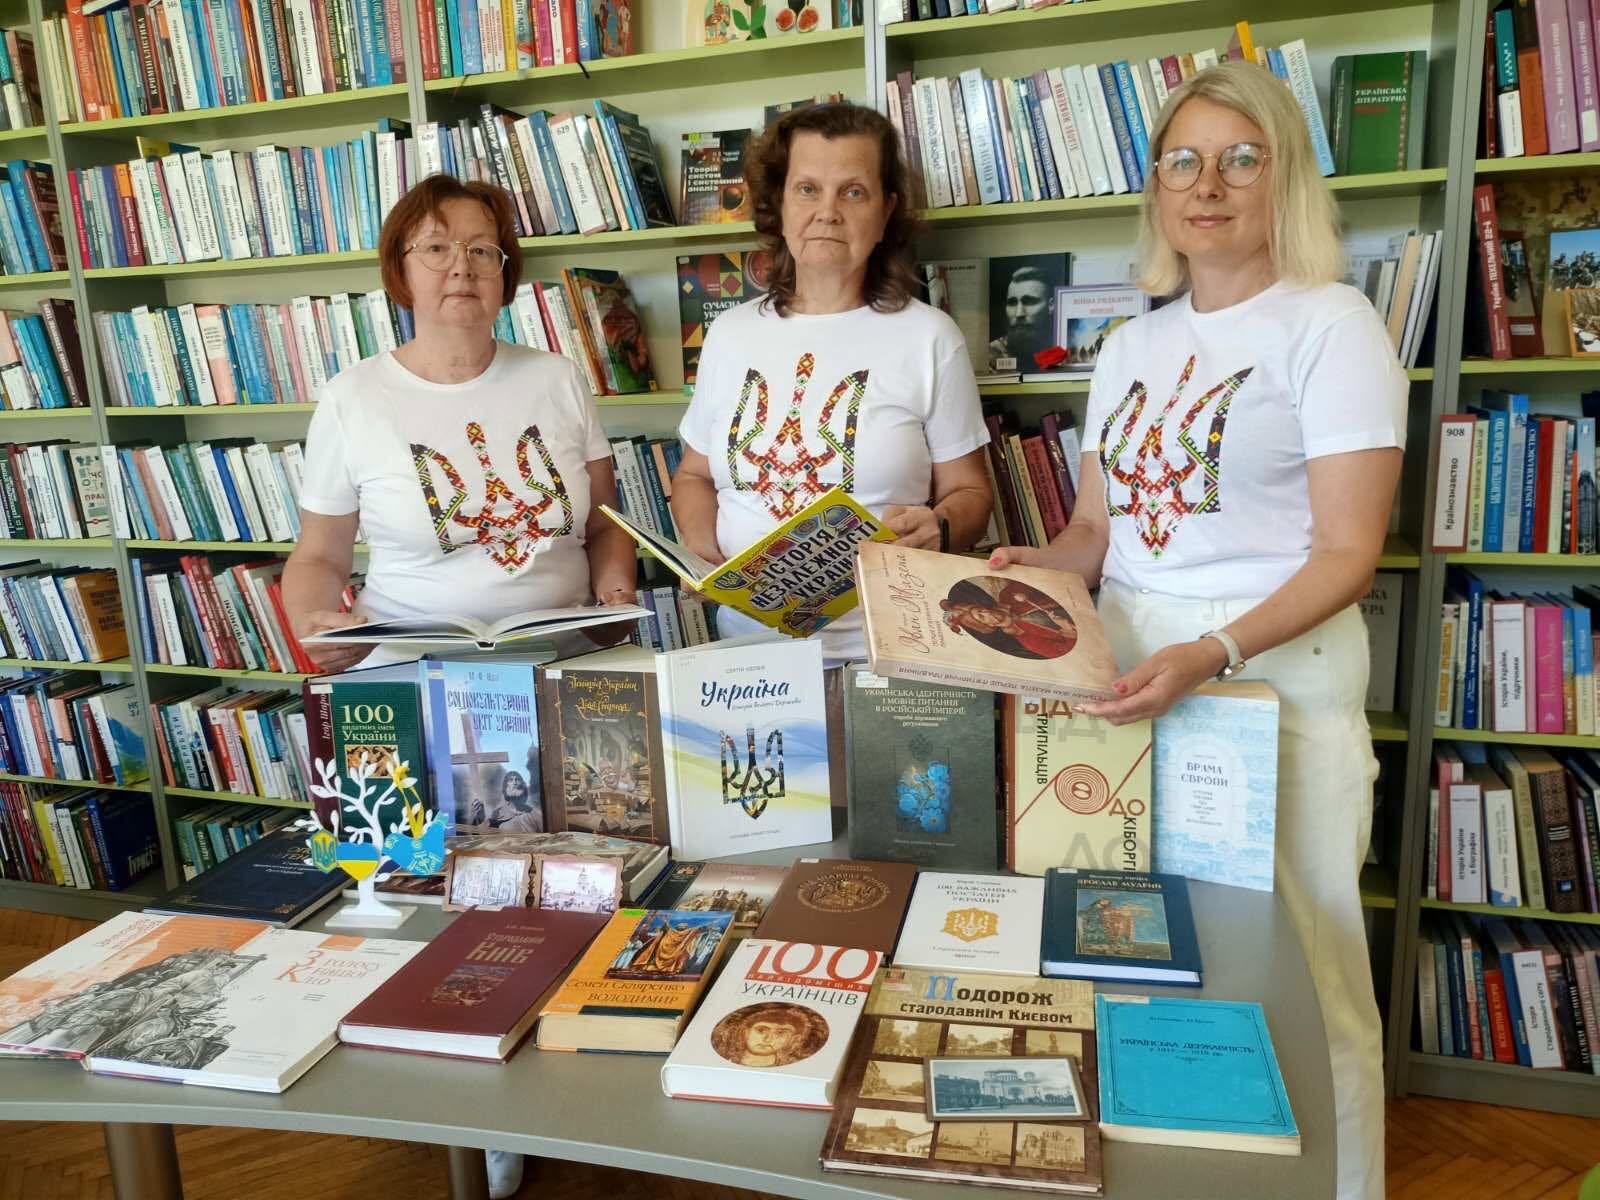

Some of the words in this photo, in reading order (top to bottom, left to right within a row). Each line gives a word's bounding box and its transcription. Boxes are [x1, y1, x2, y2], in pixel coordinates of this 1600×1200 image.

[138, 17, 158, 95] КРИМІНАЛІСТИКА
[1354, 87, 1408, 96] УКРАЇНСЬКА
[1354, 95, 1407, 105] ЛІТЕРАТУРНА
[482, 109, 500, 151] МАШИН
[688, 166, 719, 174] Теорія
[688, 172, 721, 180] систем
[687, 185, 719, 193] аналіз
[1446, 428, 1465, 437] 908
[1444, 457, 1458, 530] Країнознавство
[763, 529, 834, 580] ІСТОРІЯ
[752, 521, 878, 607] НЕЗАЛЕЖНОСТІ
[795, 549, 859, 600] УКРАЇН
[701, 679, 790, 710] Україна
[864, 688, 915, 697] УКРАЇНСЬКА
[916, 689, 977, 699] ІДЕНТИЧНІСТЬ
[882, 705, 932, 714] РОСІЙСЬКІЙ
[887, 698, 915, 706] МОВНЕ
[917, 699, 959, 707] ПИТАННЯ
[342, 704, 394, 724] 100
[343, 730, 396, 743] України
[1036, 713, 1048, 785] ТРИПІЛЬЦІВ
[1187, 762, 1223, 774] БРАМА
[1181, 774, 1229, 787] ЄВРОПИ
[1109, 798, 1146, 817] ДО
[1123, 816, 1137, 872] КІБОРГІ
[1121, 880, 1162, 889] МУДРИЙ
[749, 941, 878, 983] 100
[565, 979, 608, 991] Семен
[610, 980, 686, 993] Скляренко
[741, 982, 858, 1006] УКРАЇНЦІВ
[924, 975, 1053, 1005] Подорож
[587, 991, 679, 1005] ВОЛОДИМИР
[900, 1002, 1003, 1020] стародавнім
[1009, 1008, 1073, 1024] Києвом
[1119, 1038, 1179, 1049] УКРАЇНСЬКА
[1183, 1041, 1256, 1055] ДЕРЖАВНІСТЬ
